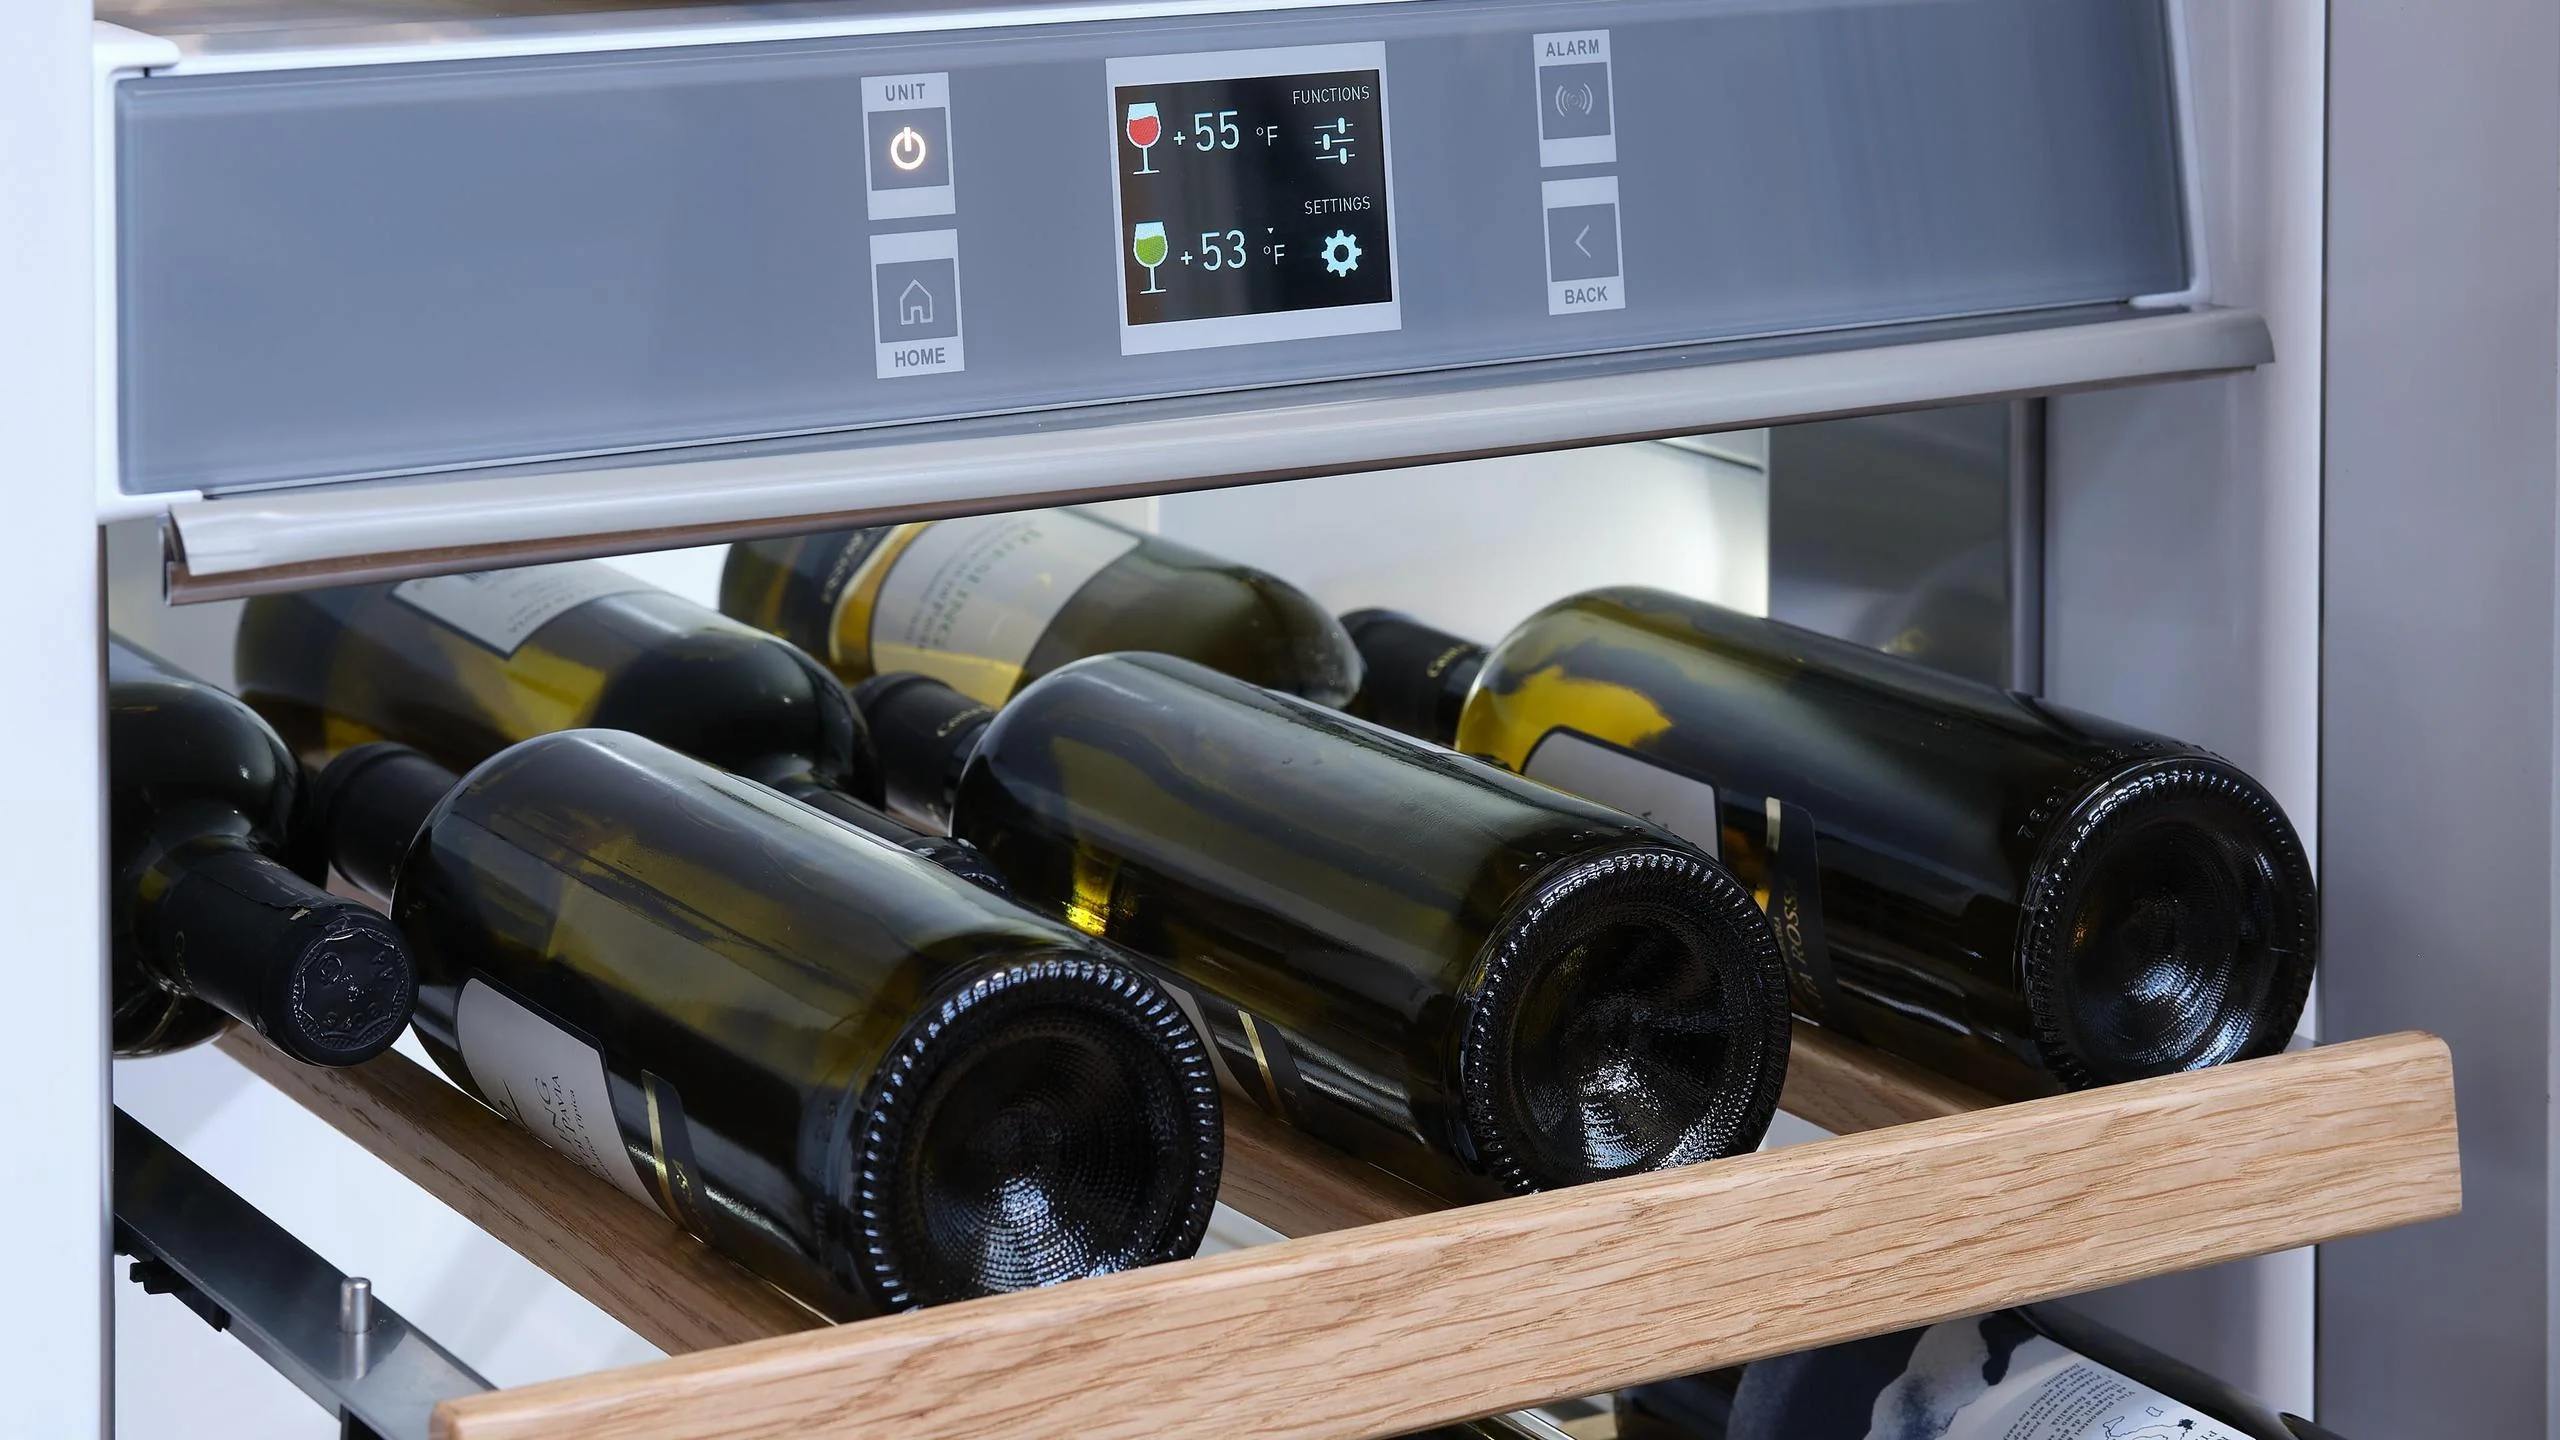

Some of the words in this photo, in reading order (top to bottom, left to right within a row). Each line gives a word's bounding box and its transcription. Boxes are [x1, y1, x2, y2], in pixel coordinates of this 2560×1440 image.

[1546, 39, 1599, 57] ALARM
[885, 83, 925, 101] UNIT
[1292, 85, 1370, 105] FUNCTIONS
[1304, 196, 1370, 215] SETTINGS
[1565, 286, 1608, 304] BACK
[895, 347, 945, 368] HOME
